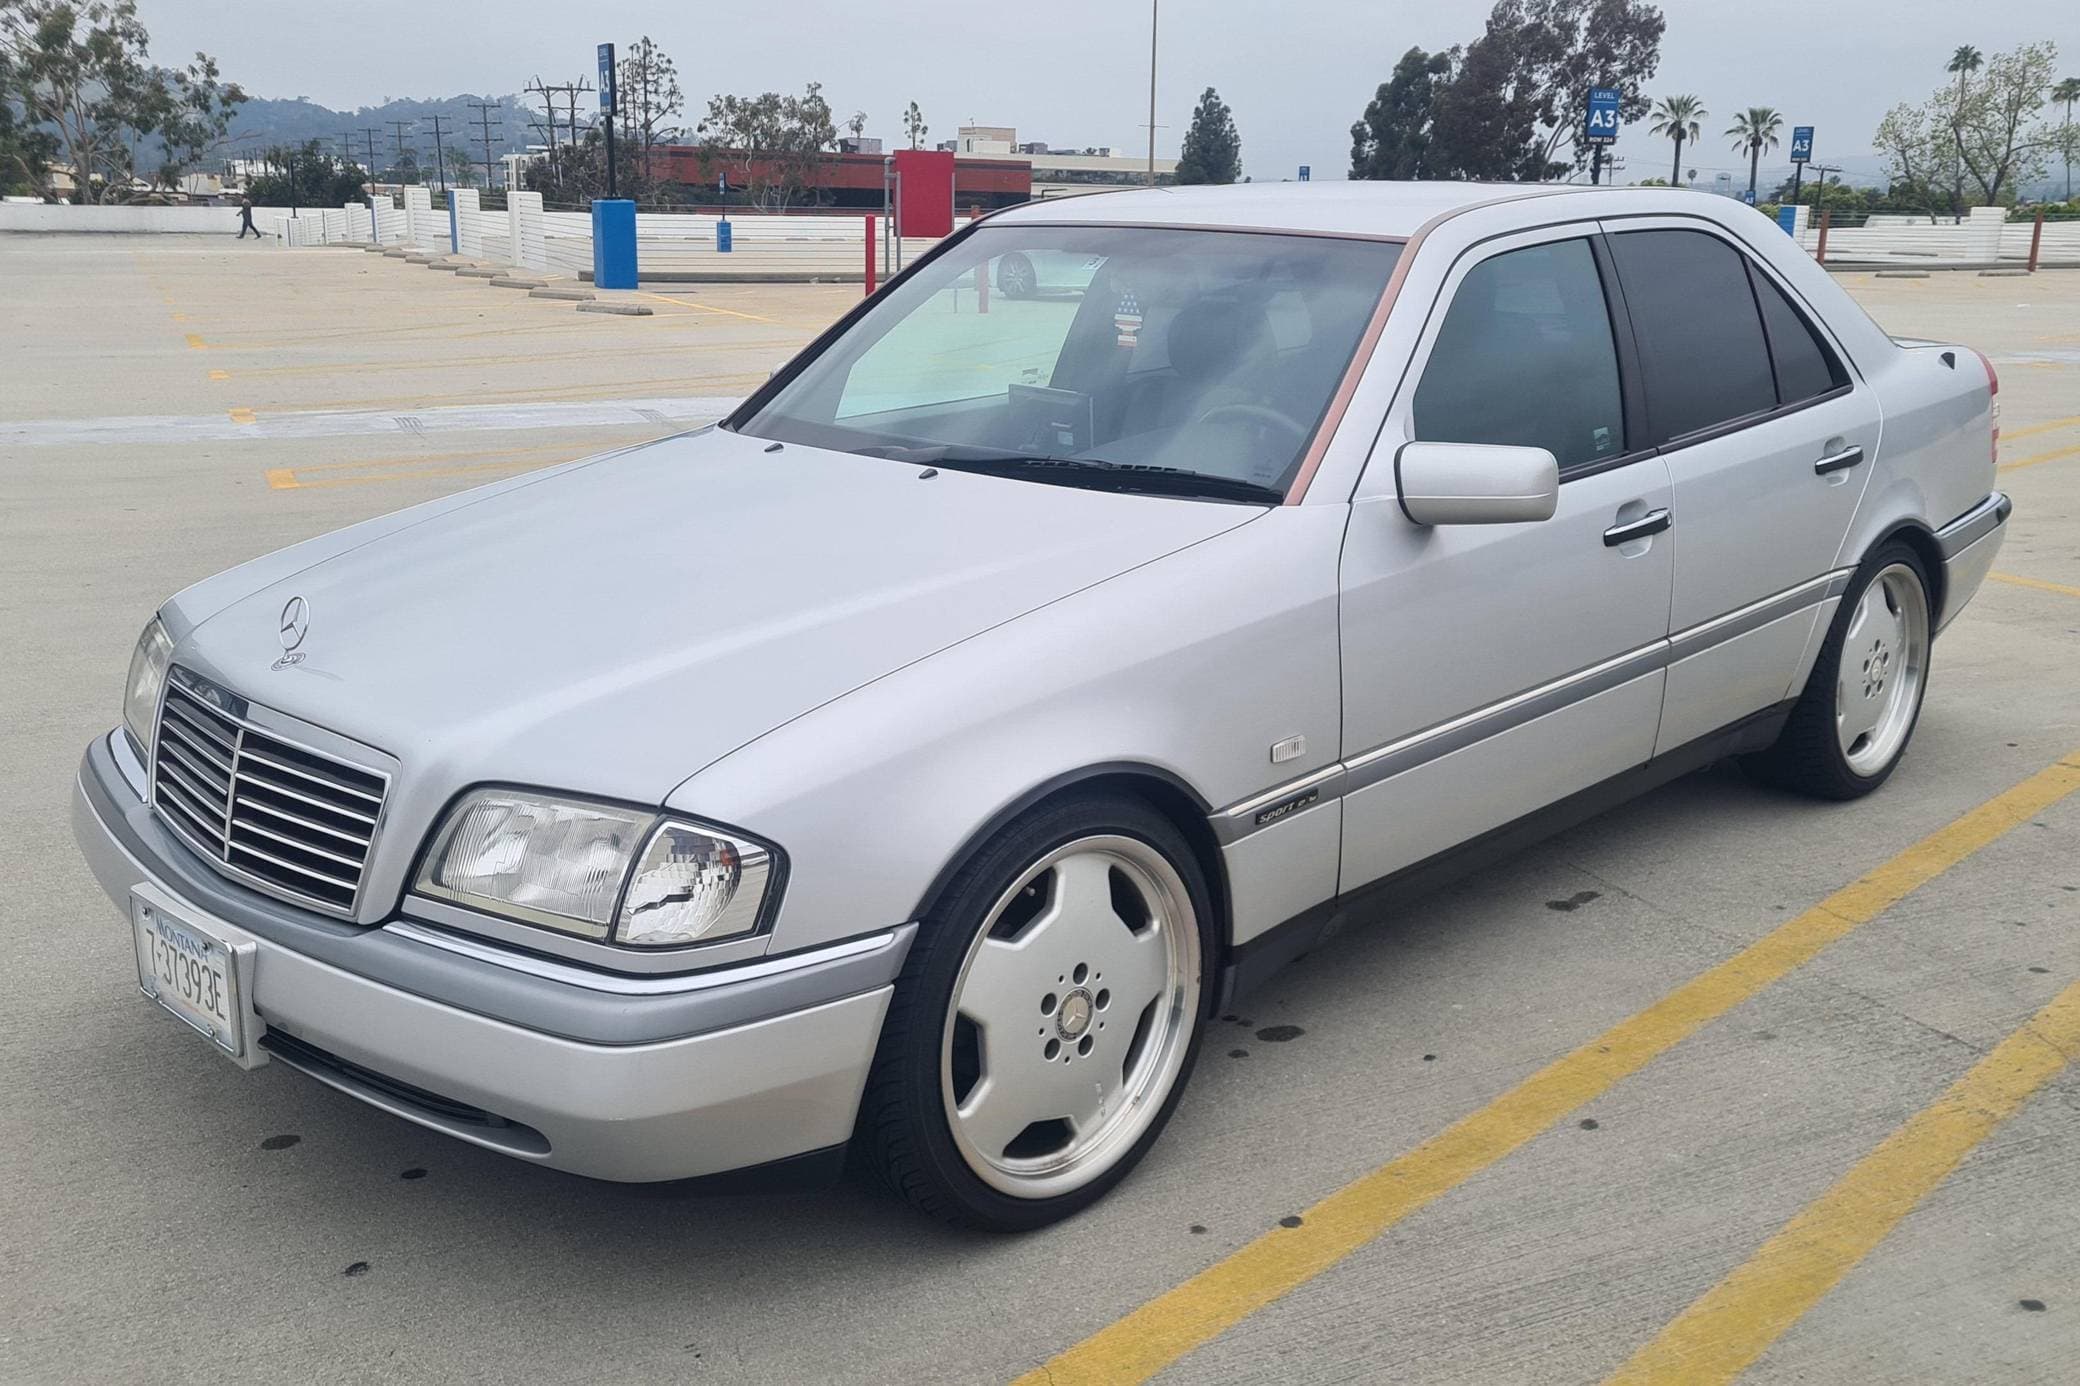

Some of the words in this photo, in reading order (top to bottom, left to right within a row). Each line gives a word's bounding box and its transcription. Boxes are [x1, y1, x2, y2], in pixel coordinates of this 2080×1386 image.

[1594, 91, 1615, 99] LEVEL
[1590, 109, 1615, 128] A3
[1793, 139, 1810, 152] A3
[155, 913, 209, 963] MONTANA
